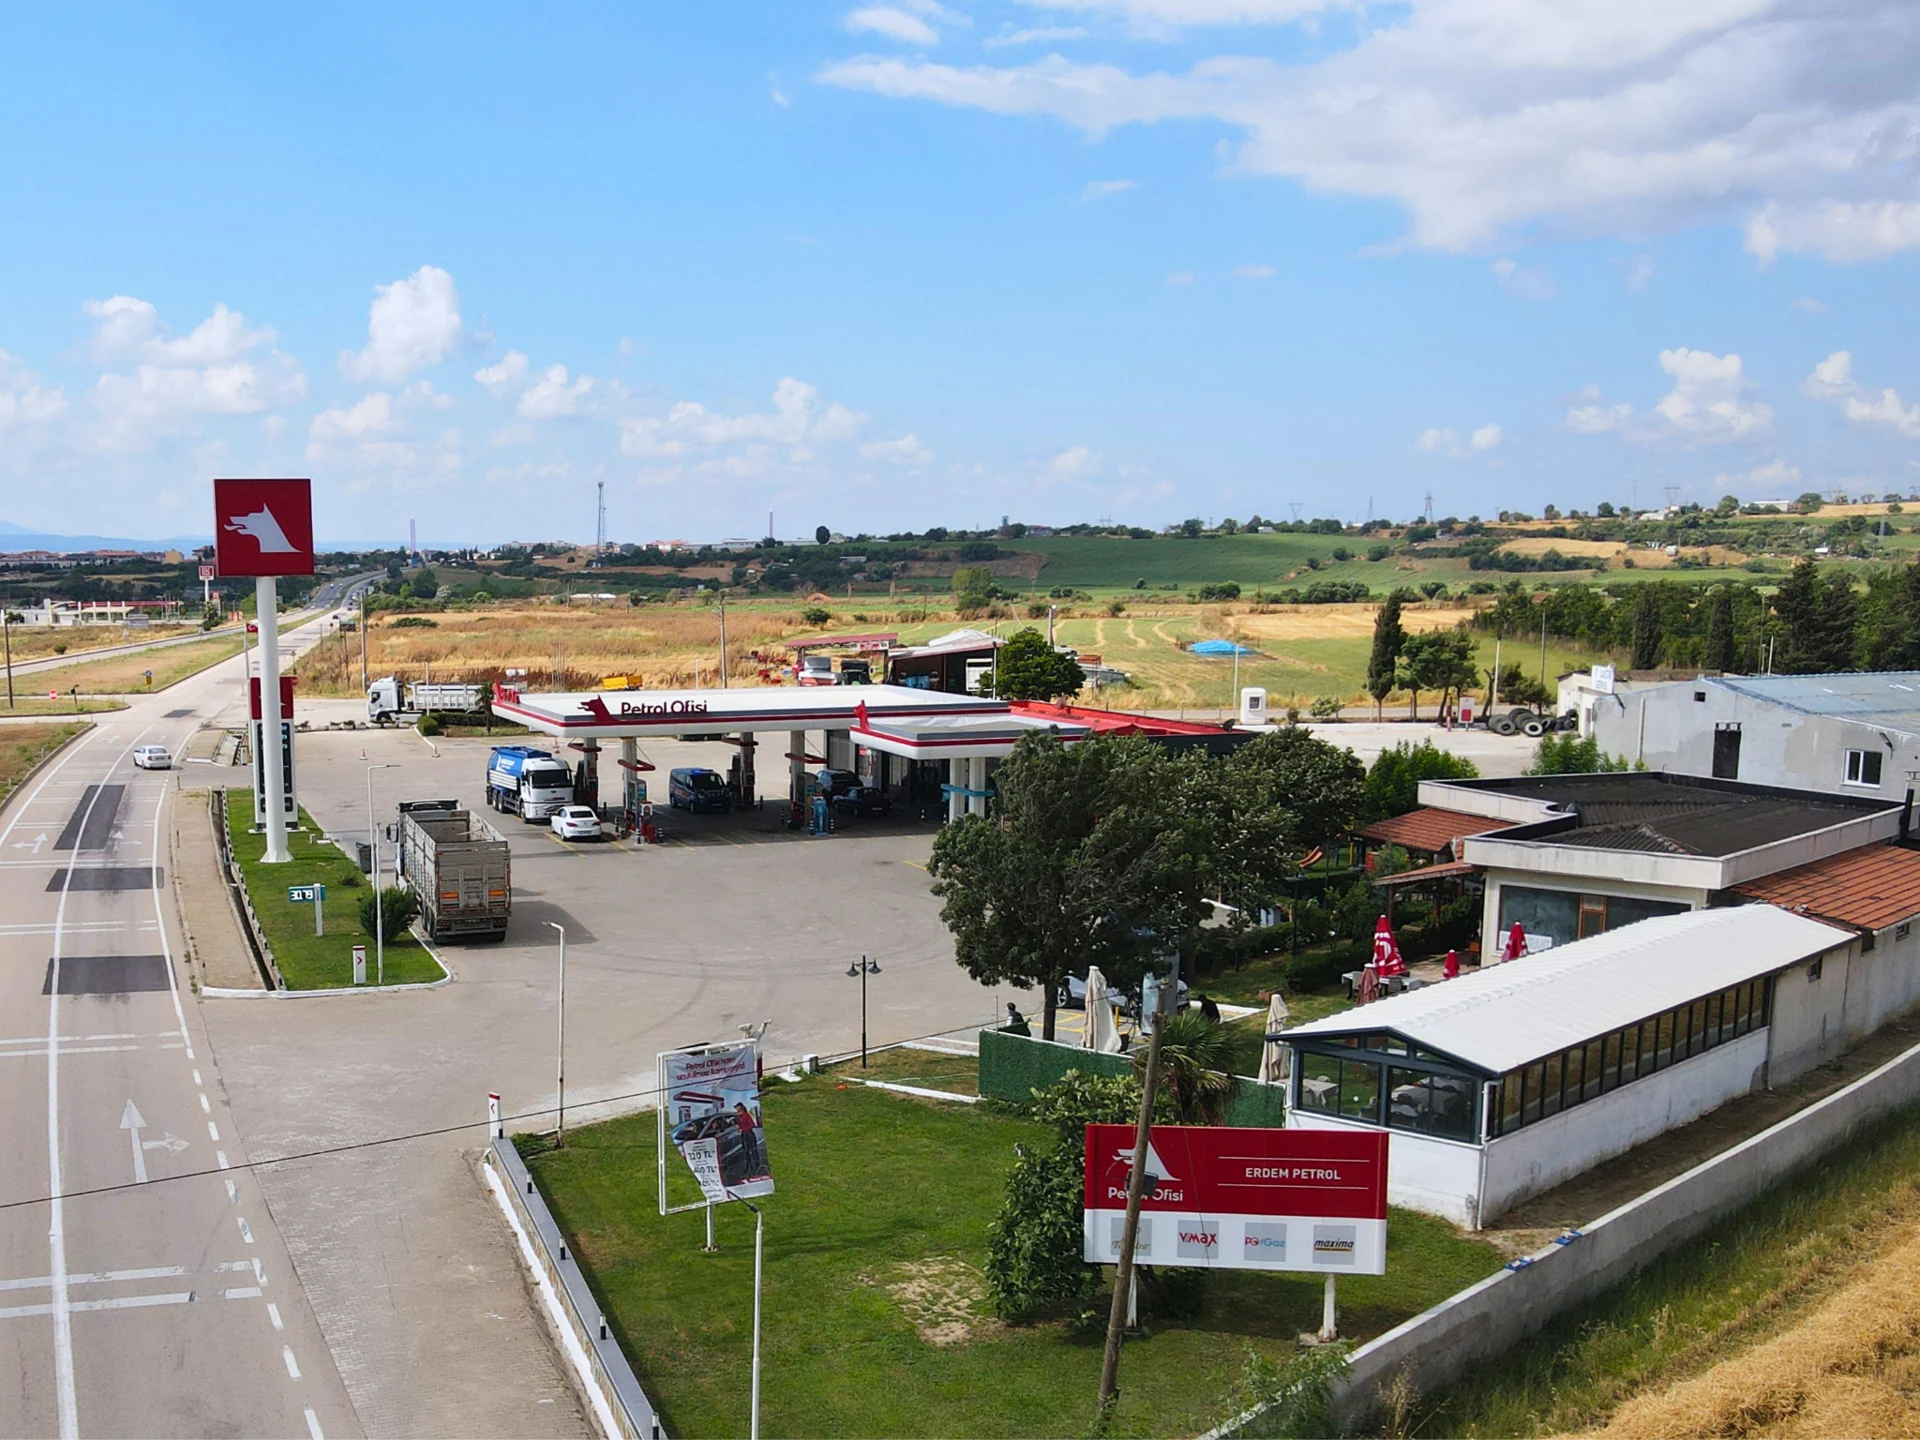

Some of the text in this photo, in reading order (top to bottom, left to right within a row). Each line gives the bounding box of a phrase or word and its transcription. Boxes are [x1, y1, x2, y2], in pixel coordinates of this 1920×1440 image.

[621, 699, 708, 716] Petrol Ofisi
[1245, 1167, 1342, 1180] ERDEM PETROL
[1313, 1239, 1355, 1249] maxima
